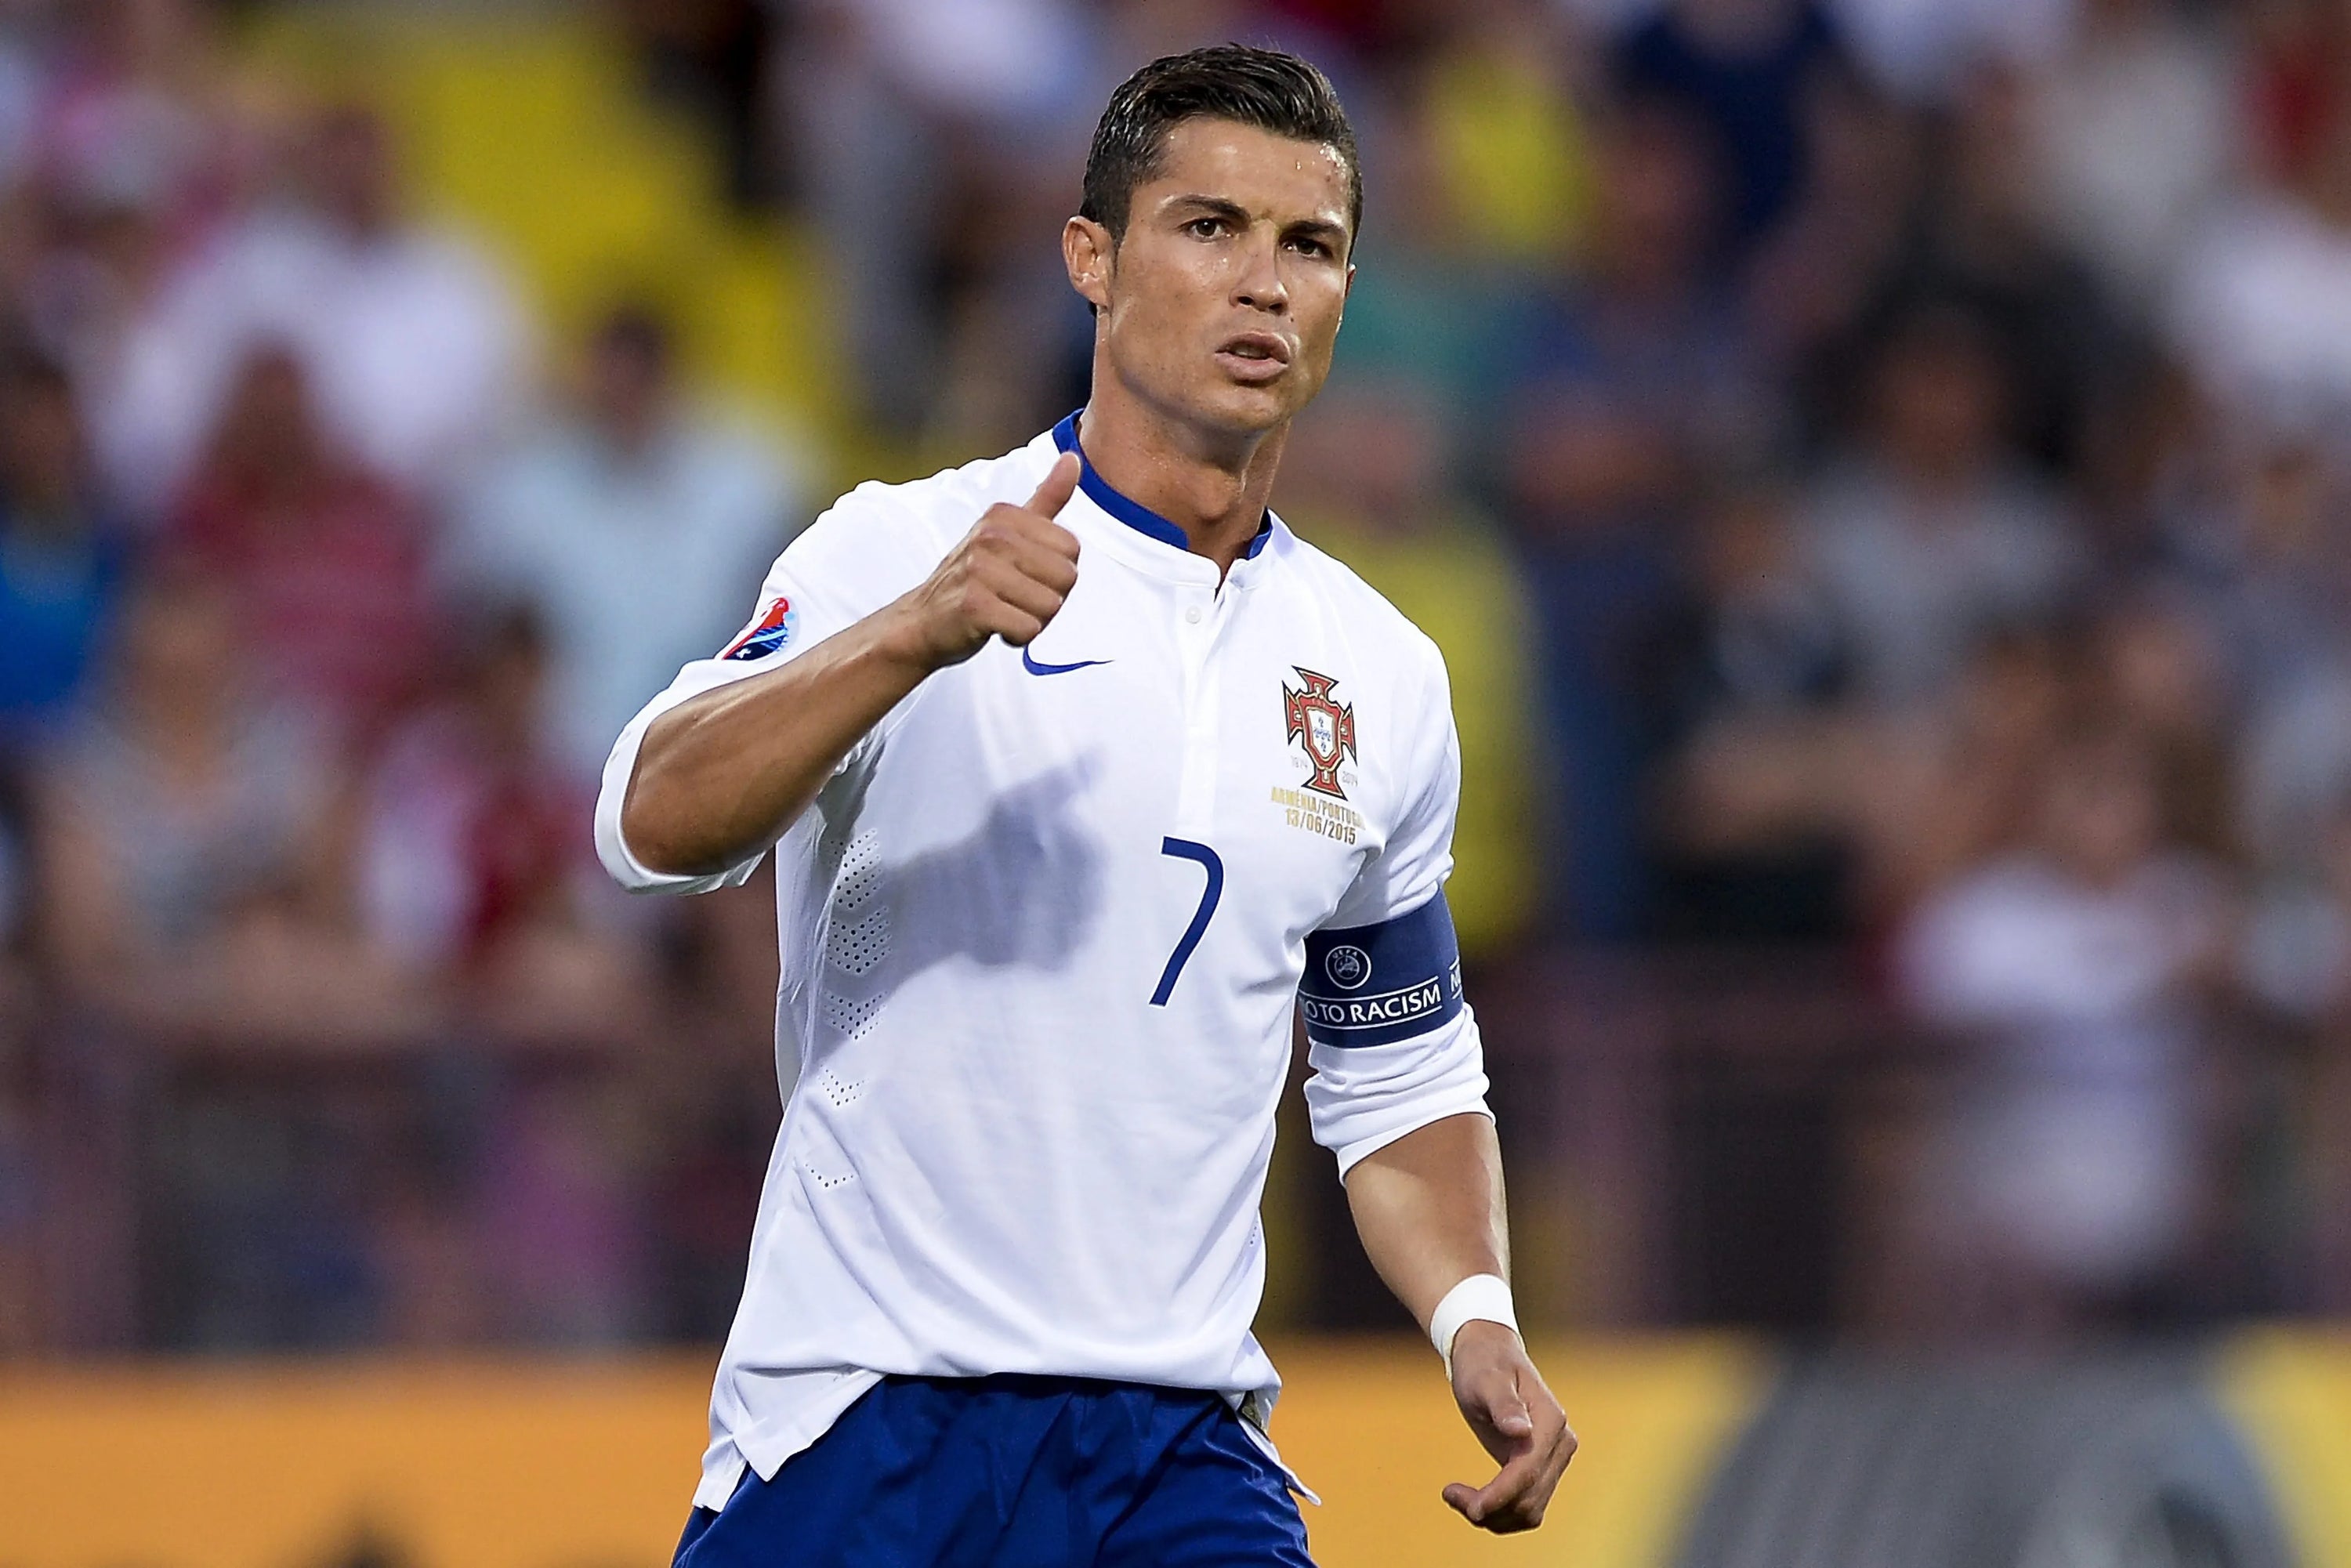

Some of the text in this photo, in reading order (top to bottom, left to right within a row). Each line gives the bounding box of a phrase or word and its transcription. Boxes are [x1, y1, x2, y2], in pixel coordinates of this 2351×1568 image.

[1285, 808, 1357, 846] 13/06/2015
[1149, 835, 1224, 1007] 7
[1331, 948, 1358, 960] UEFA
[1318, 1004, 1346, 1023] TO
[1349, 983, 1442, 1023] RACISM
